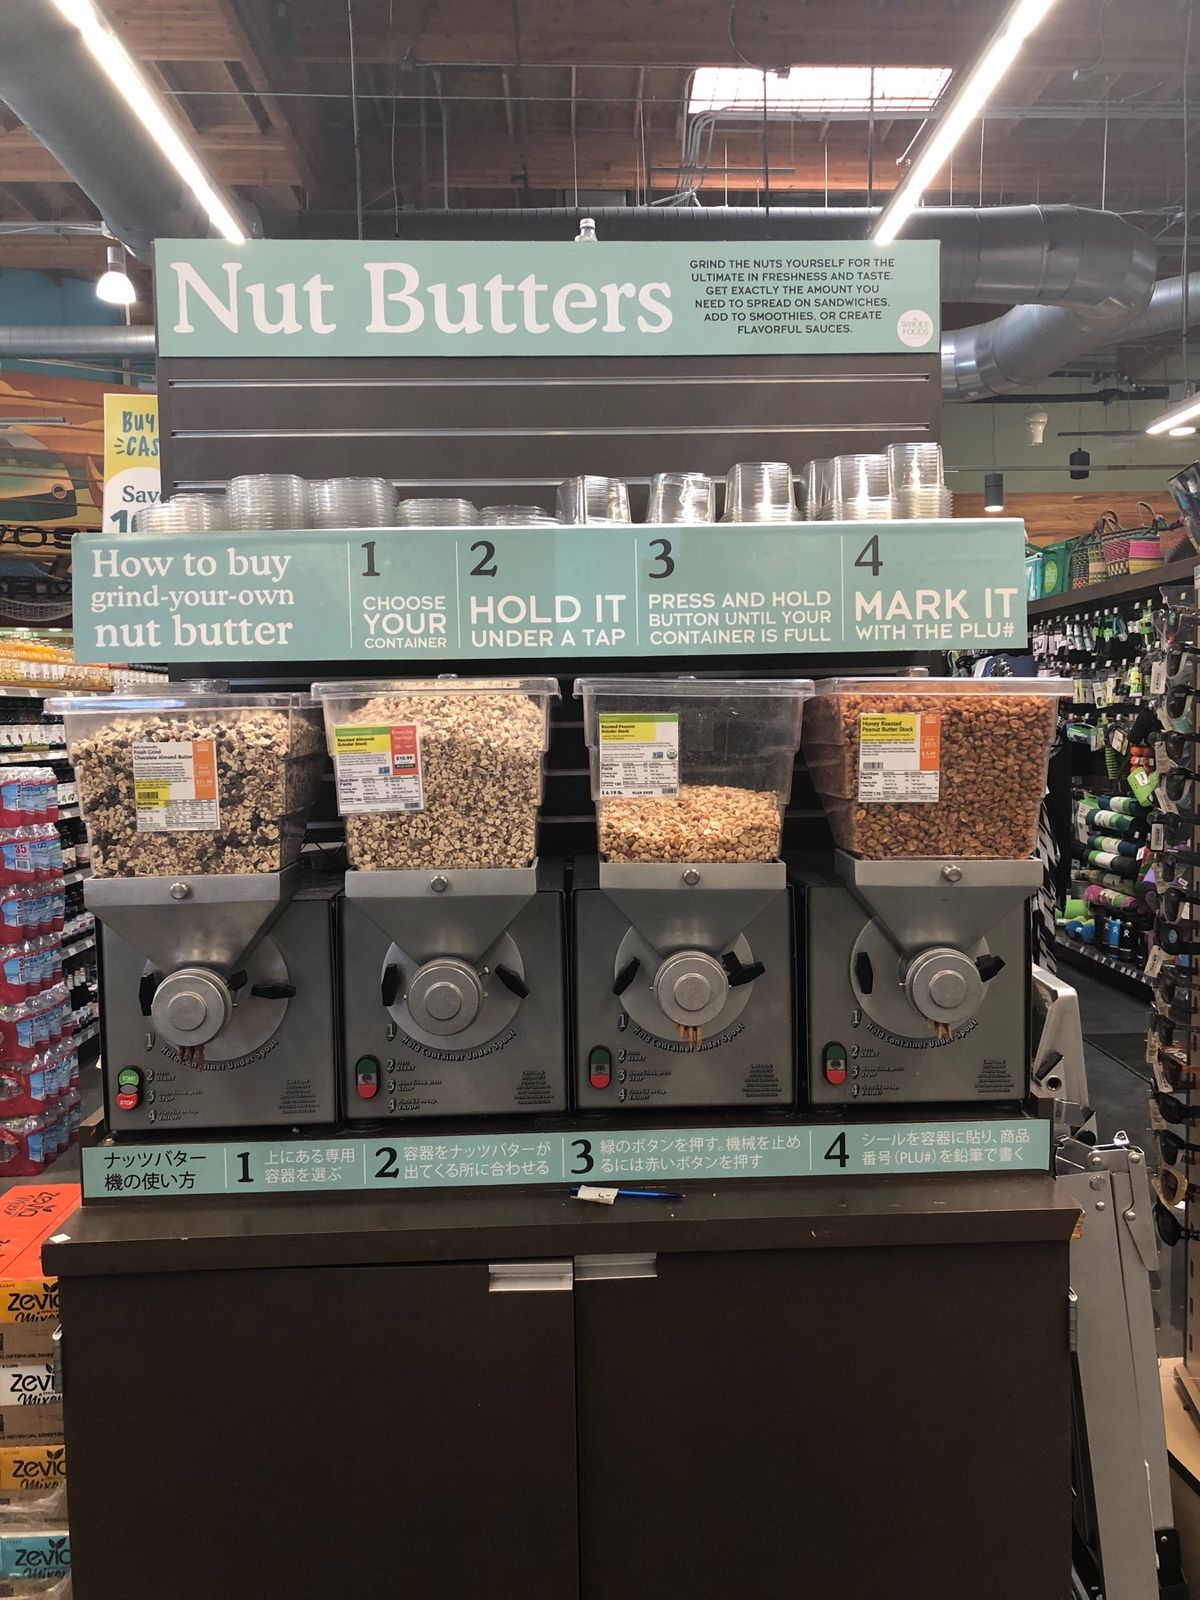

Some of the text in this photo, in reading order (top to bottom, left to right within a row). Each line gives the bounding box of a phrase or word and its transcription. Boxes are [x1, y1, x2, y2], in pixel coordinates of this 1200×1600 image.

[690, 258, 895, 269] GRIND THE NUTS YOURSELF FOR THE
[691, 272, 893, 282] ULTIMATE IN FRESHNESS AND TASTE.
[171, 262, 672, 334] Nut Butters
[706, 285, 879, 295] GET EXACTLY THE AMOUNT YOU
[695, 298, 890, 308] NEED TO SPREAD ON SANDWICHES,
[704, 311, 882, 321] ADD TO SMOOTHIES, OR CREATE
[738, 325, 853, 334] FLAVORFUL SAUCES.
[902, 328, 929, 336] FOODS
[122, 411, 157, 432] BUY
[92, 548, 291, 582] How to buy
[362, 542, 381, 577] 1
[469, 541, 498, 578] 2
[649, 539, 675, 578] 3
[855, 535, 883, 576] 4
[90, 585, 294, 612] grind-your-own
[363, 596, 446, 611] CHOOSE
[649, 591, 831, 608] PRESS AND HOLD
[856, 587, 1018, 621] MARK IT
[470, 594, 626, 624] HOLD IT
[649, 609, 831, 627] BUTTON UNTIL YOUR
[95, 615, 294, 647] nut butter
[363, 614, 447, 635] YOUR
[856, 621, 1014, 640] WITH THE PLU#
[364, 638, 447, 649] CONTAINER
[472, 628, 626, 647] UNDER A TAP
[650, 625, 830, 645] CONTAINER IS FULL
[618, 1014, 626, 1028] 1
[852, 1010, 859, 1023] 1
[146, 1033, 153, 1047] 1
[387, 1024, 394, 1037] 1
[632, 1026, 652, 1043] Hold
[721, 1023, 745, 1043] Spout
[866, 1019, 979, 1049] Hold Container Under Spout
[228, 1056, 255, 1069] Under
[255, 1039, 279, 1058] Spout
[401, 1030, 517, 1061] Hold Container Under Spout
[852, 1045, 858, 1057] 2
[387, 1059, 394, 1070] 2
[618, 1050, 625, 1061] 2
[146, 1070, 153, 1081] 2
[618, 1070, 625, 1081] 3
[852, 1065, 859, 1076] 3
[387, 1080, 395, 1091] 3
[619, 1089, 625, 1100] 4
[852, 1085, 859, 1095] 4
[147, 1090, 154, 1101] 3
[388, 1098, 395, 1109] 4
[148, 1110, 155, 1120] 4
[600, 1134, 802, 1154] 緑のボタンを押す。機械を止め
[862, 1127, 1030, 1147] シールを容器に貼り、商品
[265, 1148, 355, 1165] 上にある専用
[404, 1140, 551, 1162] 容器をナッツバターが
[570, 1139, 595, 1174] 3
[824, 1132, 850, 1168] 4
[104, 1150, 206, 1171] ナッツバター
[237, 1151, 255, 1183] 1
[375, 1147, 400, 1180] 2
[601, 1152, 762, 1173] るには赤いボタンを押す
[265, 1165, 342, 1183] 容器を選ぶ
[405, 1160, 550, 1181] 出てくる所に合わせる
[105, 1171, 196, 1192] 機の使い方
